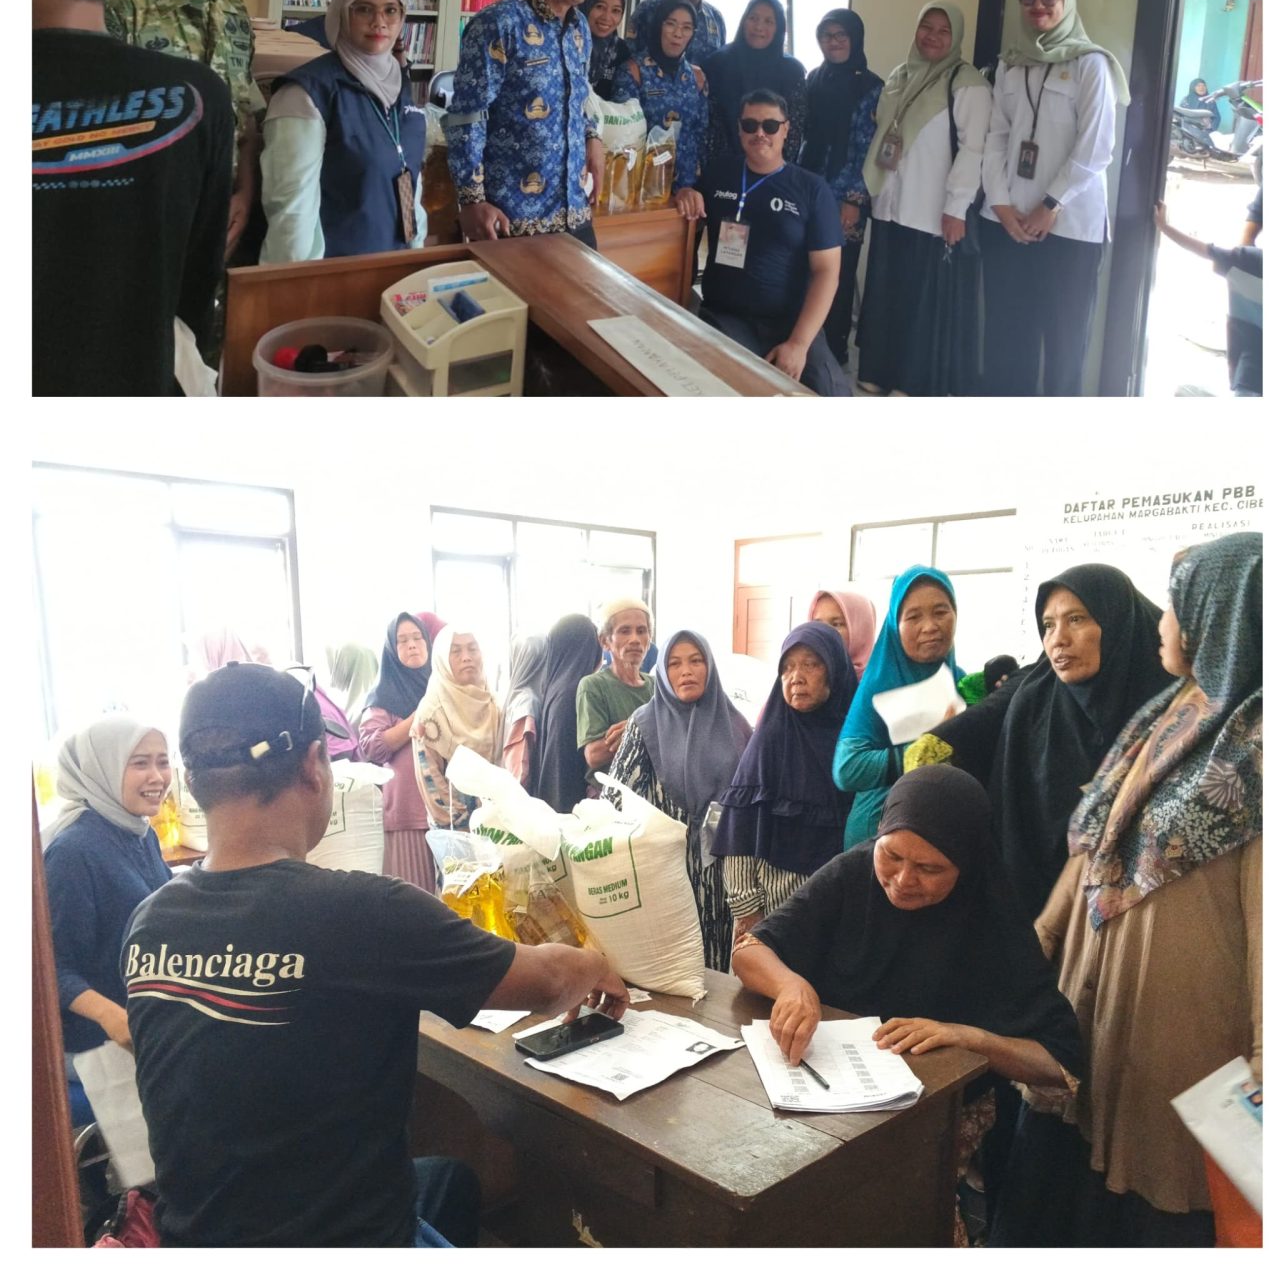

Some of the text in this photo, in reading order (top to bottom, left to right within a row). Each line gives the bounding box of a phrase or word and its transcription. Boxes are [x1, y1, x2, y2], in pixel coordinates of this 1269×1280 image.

[1064, 485, 1256, 514] DAFTAR PEMASUKAN PBB
[1063, 512, 1125, 524] KELURAHAN
[1129, 506, 1201, 520] MARGABAKTI
[1204, 502, 1233, 514] KEC.
[1191, 519, 1251, 531] REALISASI
[588, 878, 628, 896] BERAS MEDIUM
[609, 894, 618, 903] 10
[619, 891, 630, 900] kg
[125, 943, 305, 988] Balenciaga
